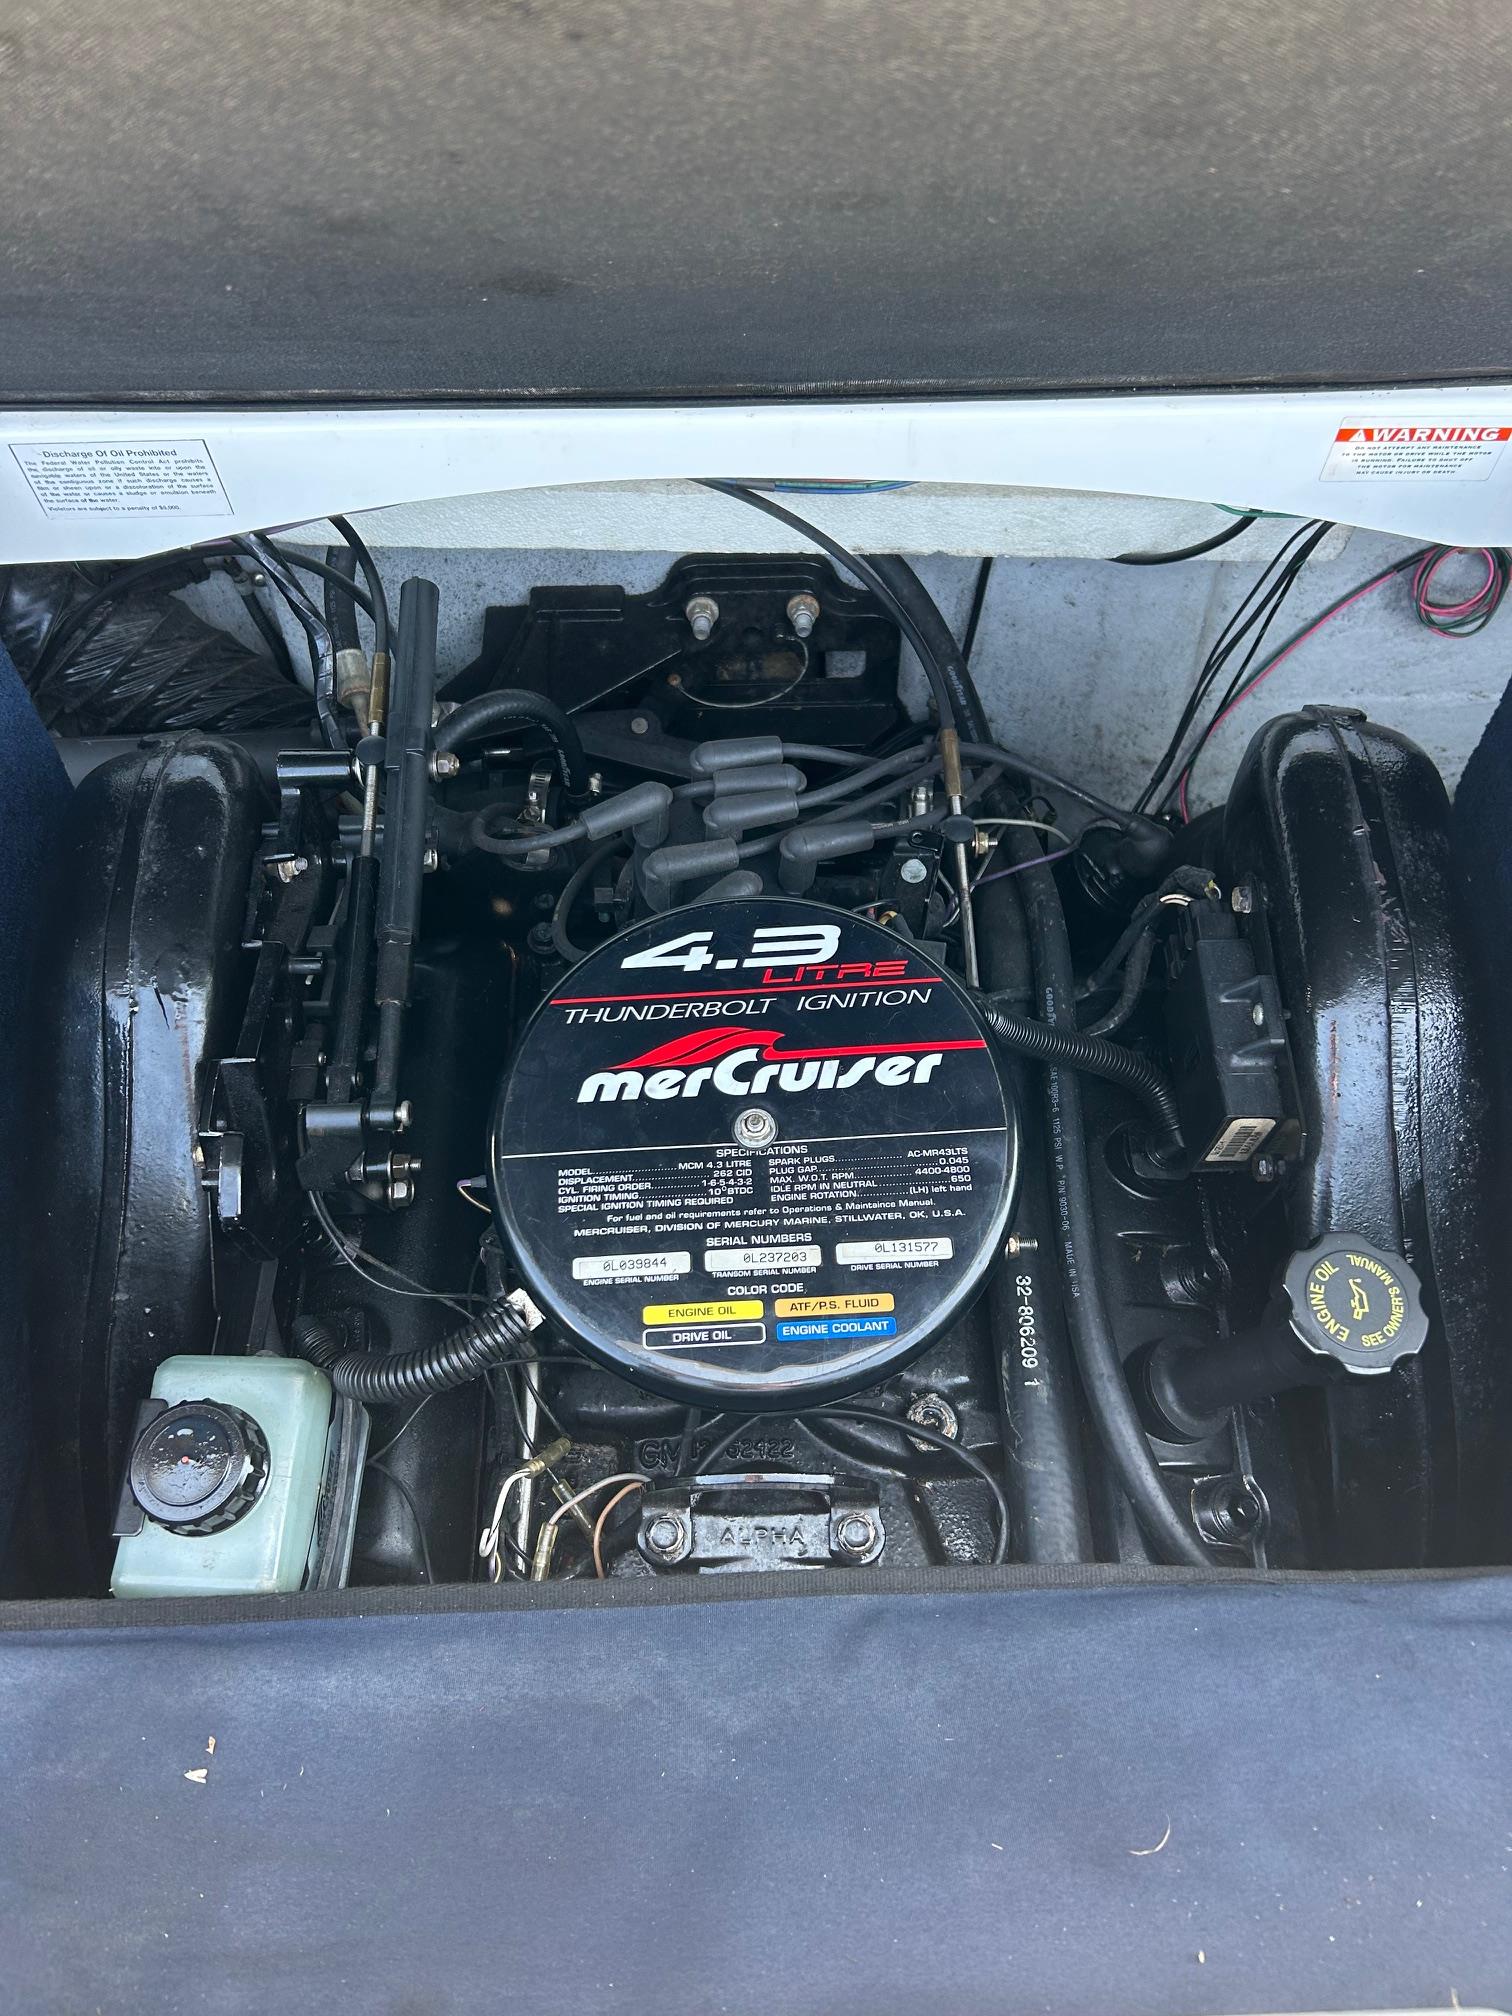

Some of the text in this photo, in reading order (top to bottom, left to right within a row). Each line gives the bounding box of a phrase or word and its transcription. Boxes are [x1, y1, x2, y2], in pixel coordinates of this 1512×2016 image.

[1373, 428, 1501, 441] WARNING
[42, 450, 93, 458] Discharge
[621, 924, 841, 971] 4.3
[762, 960, 909, 985] LITRE
[564, 988, 932, 1024] THUNDERBOLT IGNITION
[716, 1146, 808, 1158] SPECIFICATIONS
[1054, 1138, 1062, 1150] PSI
[768, 1147, 968, 1166] SPARK PLUGS AC-MR43LTS
[558, 1168, 593, 1176] MODEL
[678, 1162, 704, 1170] MCM
[726, 1160, 752, 1168] LITRE
[769, 1166, 795, 1175] PLUG
[939, 1157, 969, 1165] 0.045
[558, 1174, 634, 1186] DISPLACEMENT
[713, 1170, 734, 1178] 262
[770, 1166, 970, 1184] MAX. W.O.T. RPM 4400-4800
[558, 1178, 752, 1195] CYL. FIRING ORDER 1-6-5-4-3-2
[770, 1175, 971, 1193] IDLE RPM IN NEUTRAL 650
[558, 1194, 601, 1204] IGNITION
[604, 1192, 639, 1201] TIMING
[771, 1184, 972, 1202] ENGINE ROTATION (LH) left hand
[558, 1197, 734, 1213] SPECIAL IGNITION TIMING REQUIRED
[607, 1214, 623, 1223] For
[626, 1213, 643, 1222] fuel
[645, 1212, 663, 1220] and
[666, 1211, 676, 1219] oil
[679, 1209, 741, 1220] requirements
[743, 1208, 767, 1216] refer
[770, 1206, 780, 1214] to
[782, 1204, 832, 1215] Operations
[835, 1203, 843, 1211] &
[899, 1199, 936, 1207] Manual.
[574, 1209, 966, 1237] MERCRUISER, DIVISION OF MERCURY MARINE, STILLWATER, OK, U.S.A.
[706, 1233, 812, 1247] SERIAL NUMBERS
[875, 1242, 938, 1253] 0L131577
[603, 1257, 667, 1272] 0L039844
[744, 1252, 807, 1264] 0L237203
[850, 1260, 939, 1272] DRIVE SERIAL NUMBER
[712, 1266, 816, 1278] TRANSOM SERIAL NUMBER
[583, 1274, 679, 1287] ENGINE SERIAL NUMBER
[727, 1283, 804, 1296] COLOR CODE
[790, 1298, 879, 1311] ATF/P.S. FLUID
[1310, 1260, 1350, 1342] ENGINE OIL
[1346, 1254, 1404, 1347] SEE OWNER'S MANUAL
[668, 1306, 736, 1318] ENGINE OIL
[782, 1321, 889, 1336] ENGINE COOLANT
[1016, 1275, 1039, 1369] 32-806209
[672, 1330, 732, 1343] DRIVE OIL
[720, 1526, 805, 1545] ALPHA
